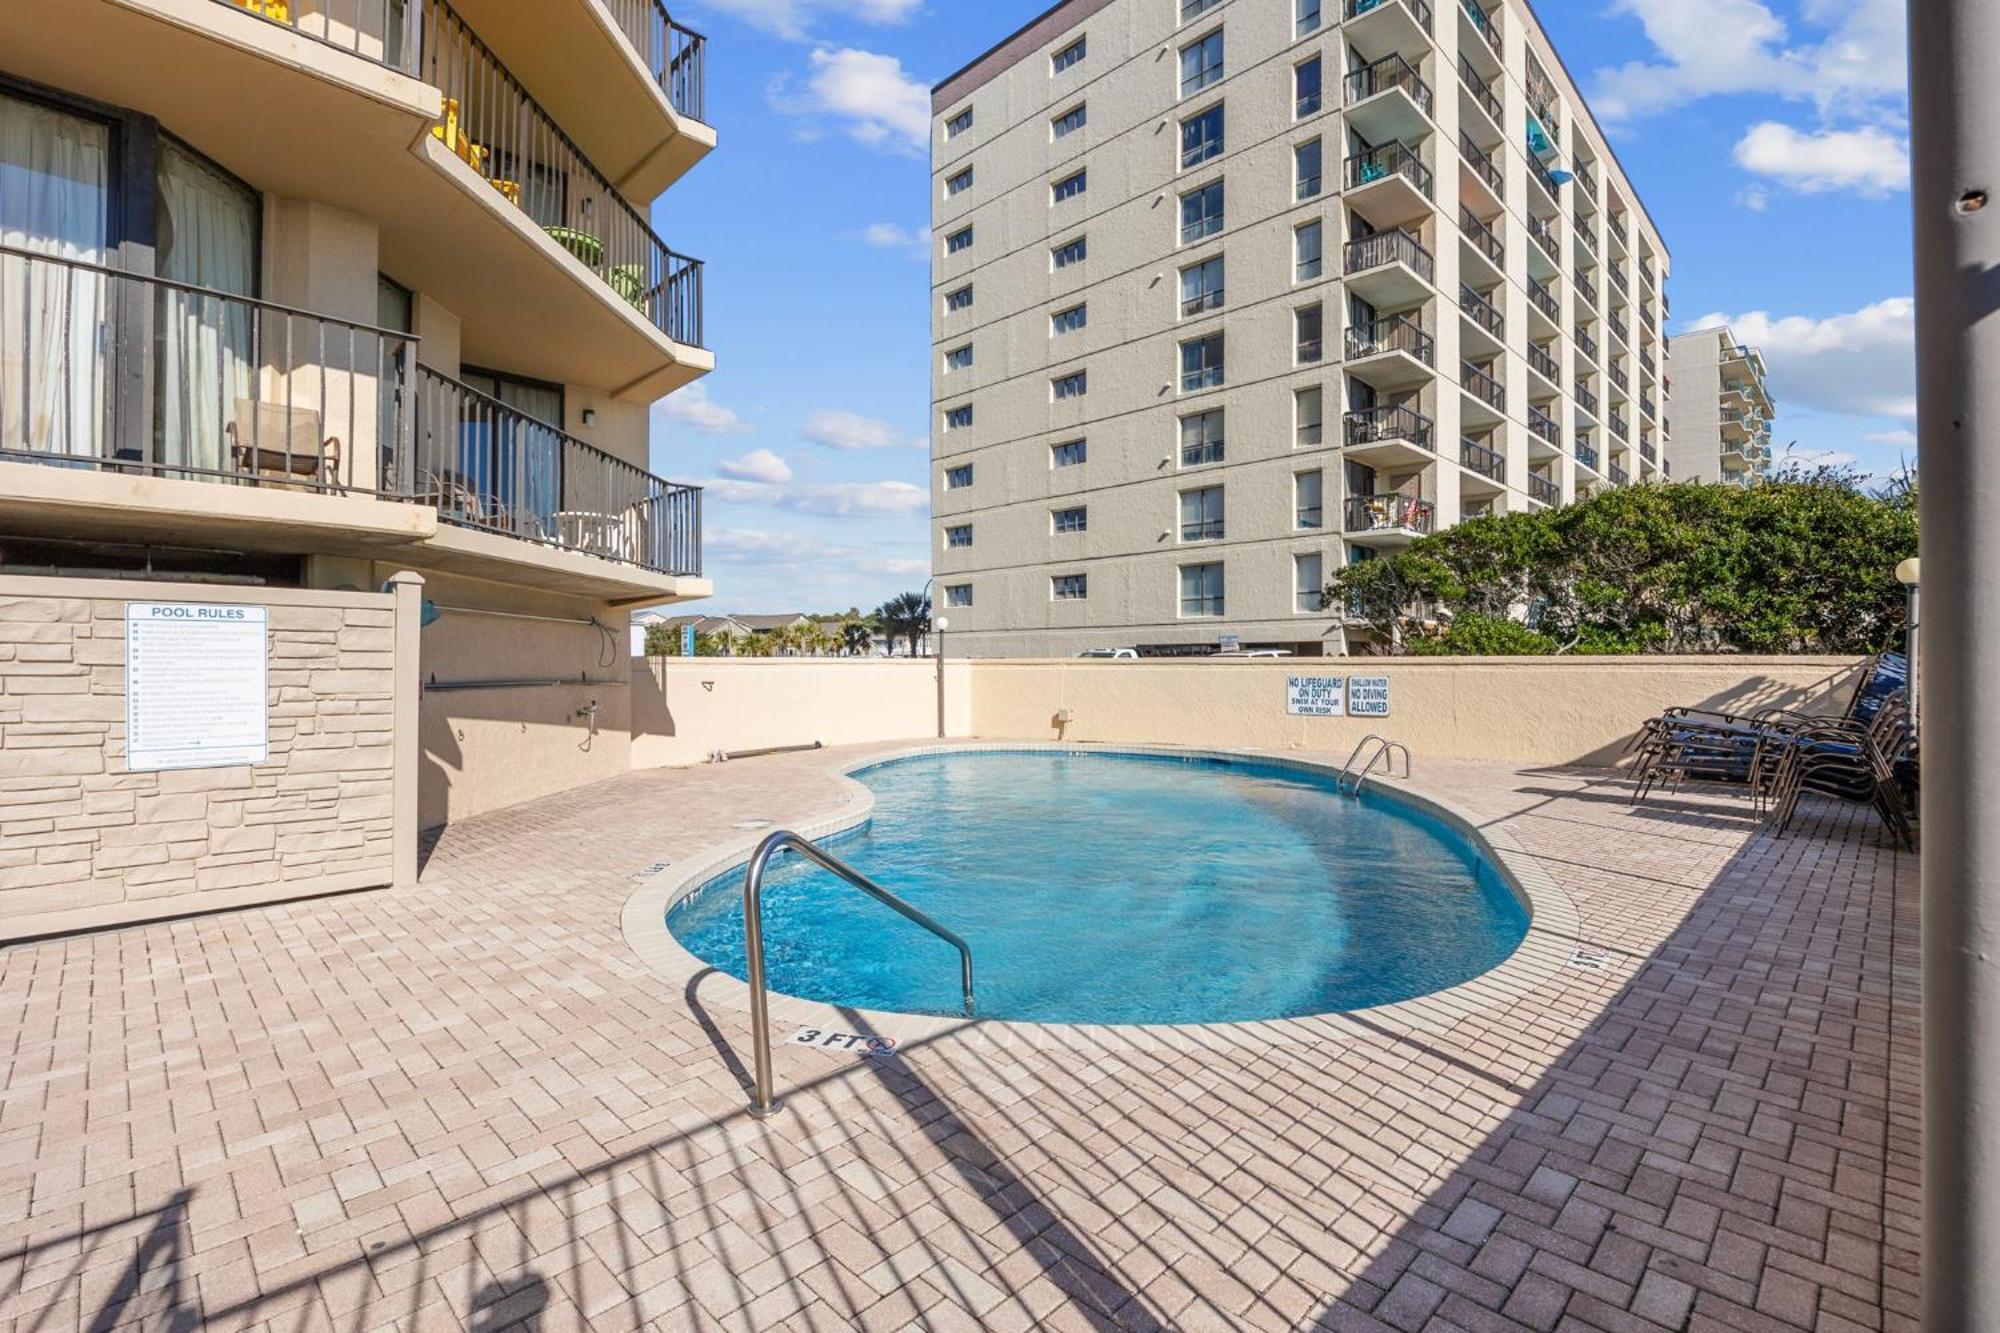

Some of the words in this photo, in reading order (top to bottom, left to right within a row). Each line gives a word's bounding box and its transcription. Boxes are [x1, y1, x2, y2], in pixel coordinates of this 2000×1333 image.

[151, 607, 193, 618] POOL
[198, 608, 245, 619] RULES
[1288, 677, 1299, 688] NO
[1301, 678, 1342, 689] LIFEGUARD
[1298, 688, 1309, 698] ON
[1312, 688, 1332, 698] DUTY
[1351, 688, 1361, 699] NO
[1363, 688, 1387, 700] DIVING
[1315, 706, 1332, 714] RISK
[1351, 701, 1388, 713] ALLOWED
[797, 1029, 822, 1042] 3
[822, 1032, 866, 1049] FT
